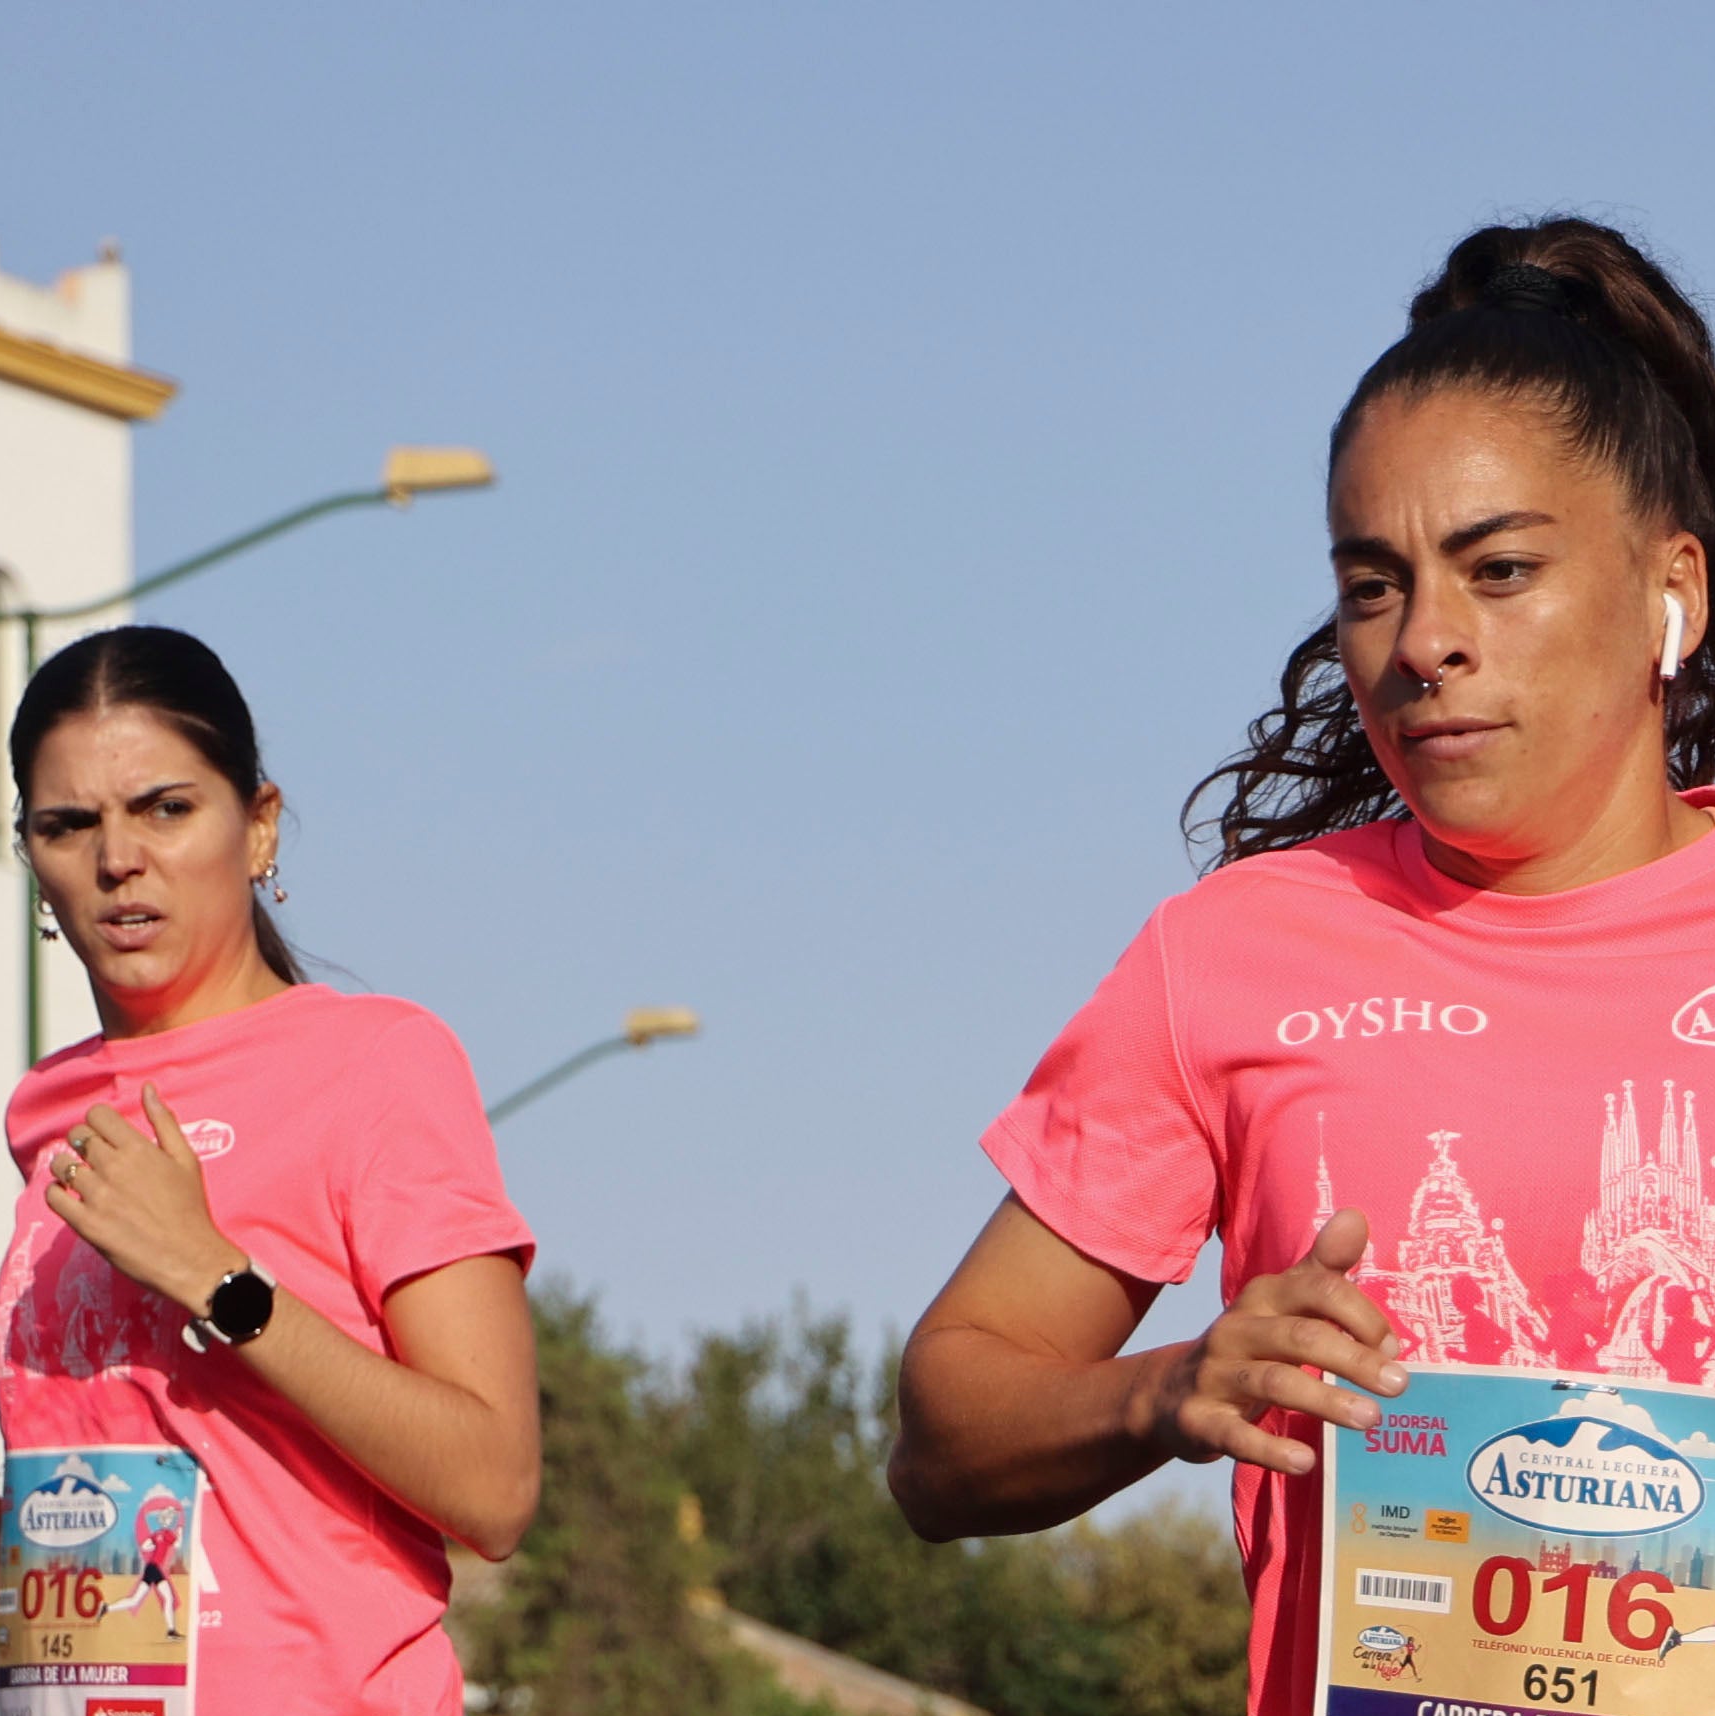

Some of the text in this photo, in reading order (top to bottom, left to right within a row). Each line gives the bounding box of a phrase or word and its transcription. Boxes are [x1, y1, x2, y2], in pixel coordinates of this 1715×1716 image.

[1277, 996, 1488, 1046] OYSHO
[1387, 1414, 1449, 1431] DORSAL
[1364, 1428, 1448, 1458] SUMA
[1519, 1452, 1681, 1479] CENTRAL LECHERA
[1482, 1451, 1687, 1515] ASTURIANA
[1380, 1504, 1411, 1520] IMD
[21, 1567, 105, 1620] 016
[1471, 1553, 1676, 1652] 016
[41, 1633, 74, 1658] 145
[1529, 1646, 1594, 1662] VIOLENCIA
[1596, 1653, 1613, 1663] DE
[1615, 1653, 1667, 1669] GÉNERO
[61, 1666, 78, 1683] LA
[79, 1665, 130, 1684] MUJER
[1523, 1663, 1599, 1707] 651
